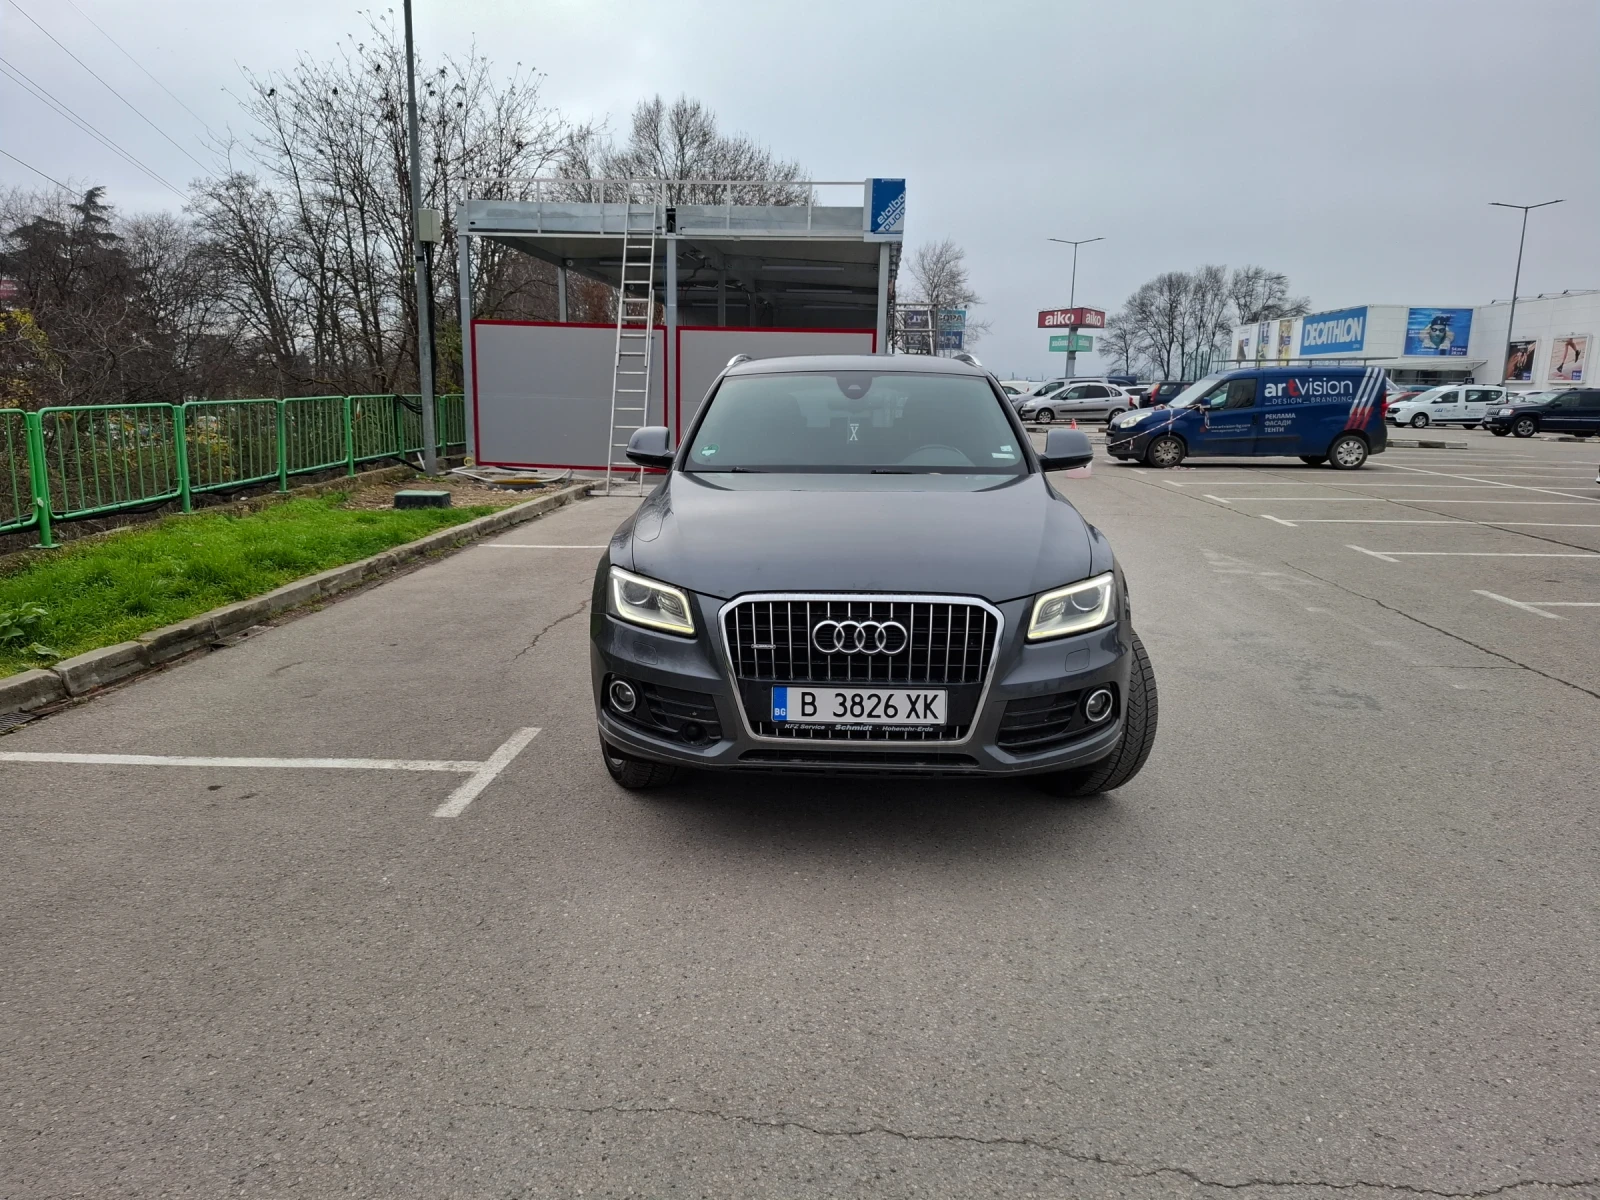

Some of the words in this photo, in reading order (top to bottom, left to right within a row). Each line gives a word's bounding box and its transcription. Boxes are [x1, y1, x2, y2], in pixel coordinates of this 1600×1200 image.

[1044, 311, 1075, 326] aiko
[1085, 311, 1102, 326] aiko
[1303, 316, 1364, 347] DECATHLON
[1265, 412, 1296, 420] РЕКЛАМА
[1264, 419, 1292, 427] ФАСАДИ
[774, 707, 787, 716] BG
[801, 691, 818, 717] B
[832, 692, 899, 719] 3826
[905, 693, 940, 720] XK
[834, 724, 873, 732] Schmidt
